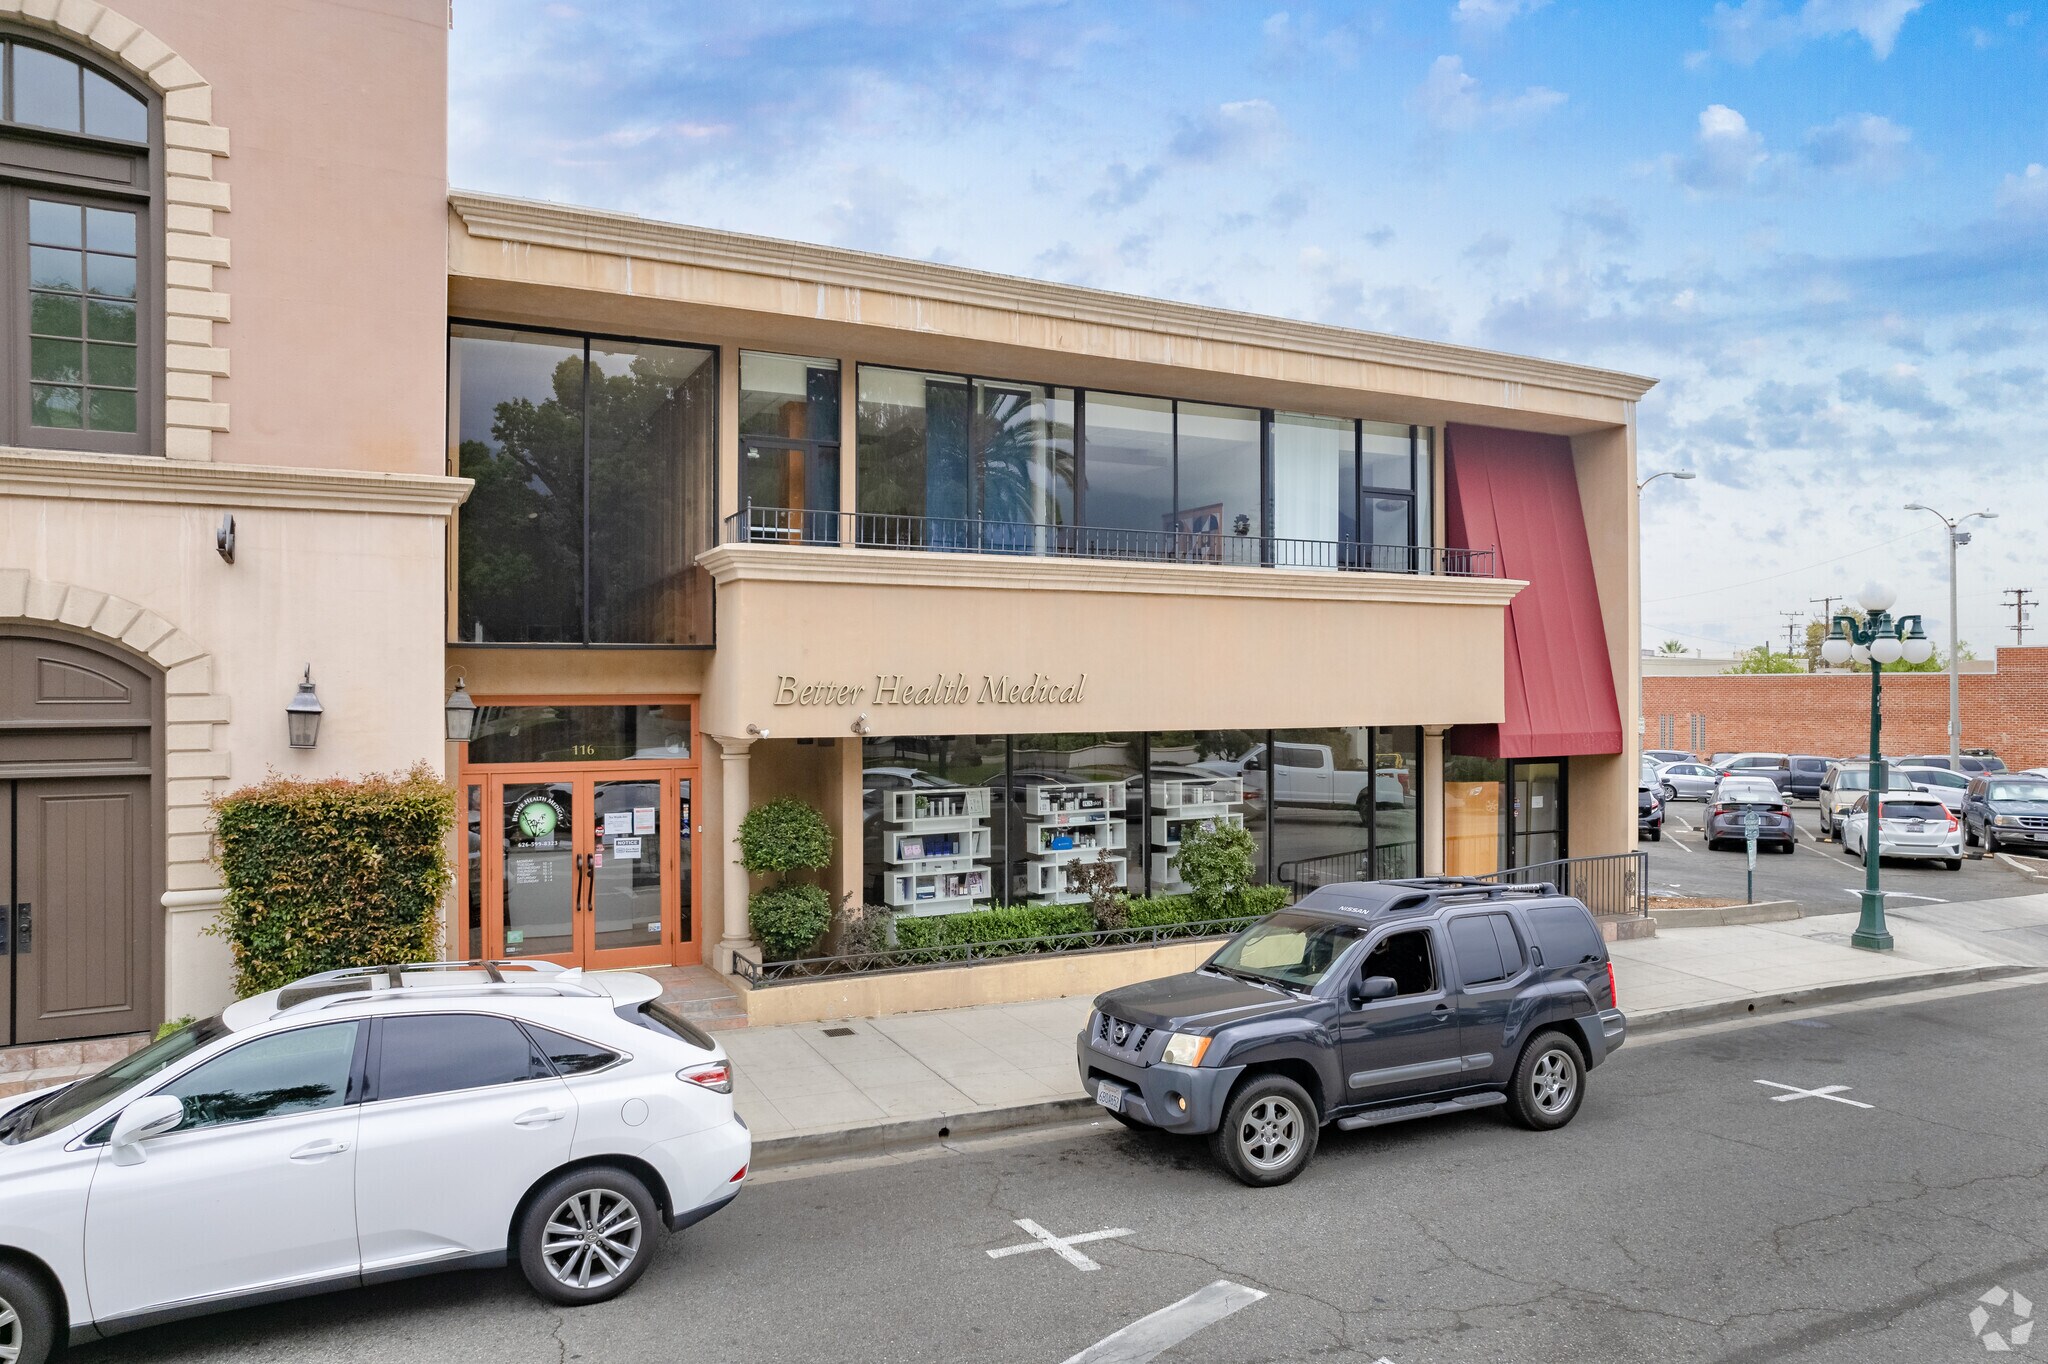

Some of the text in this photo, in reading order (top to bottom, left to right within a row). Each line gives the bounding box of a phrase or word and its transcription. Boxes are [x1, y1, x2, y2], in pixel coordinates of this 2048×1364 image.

[773, 672, 1088, 706] Better Health Medical
[571, 744, 595, 755] 116
[1338, 905, 1370, 915] NISSAN
